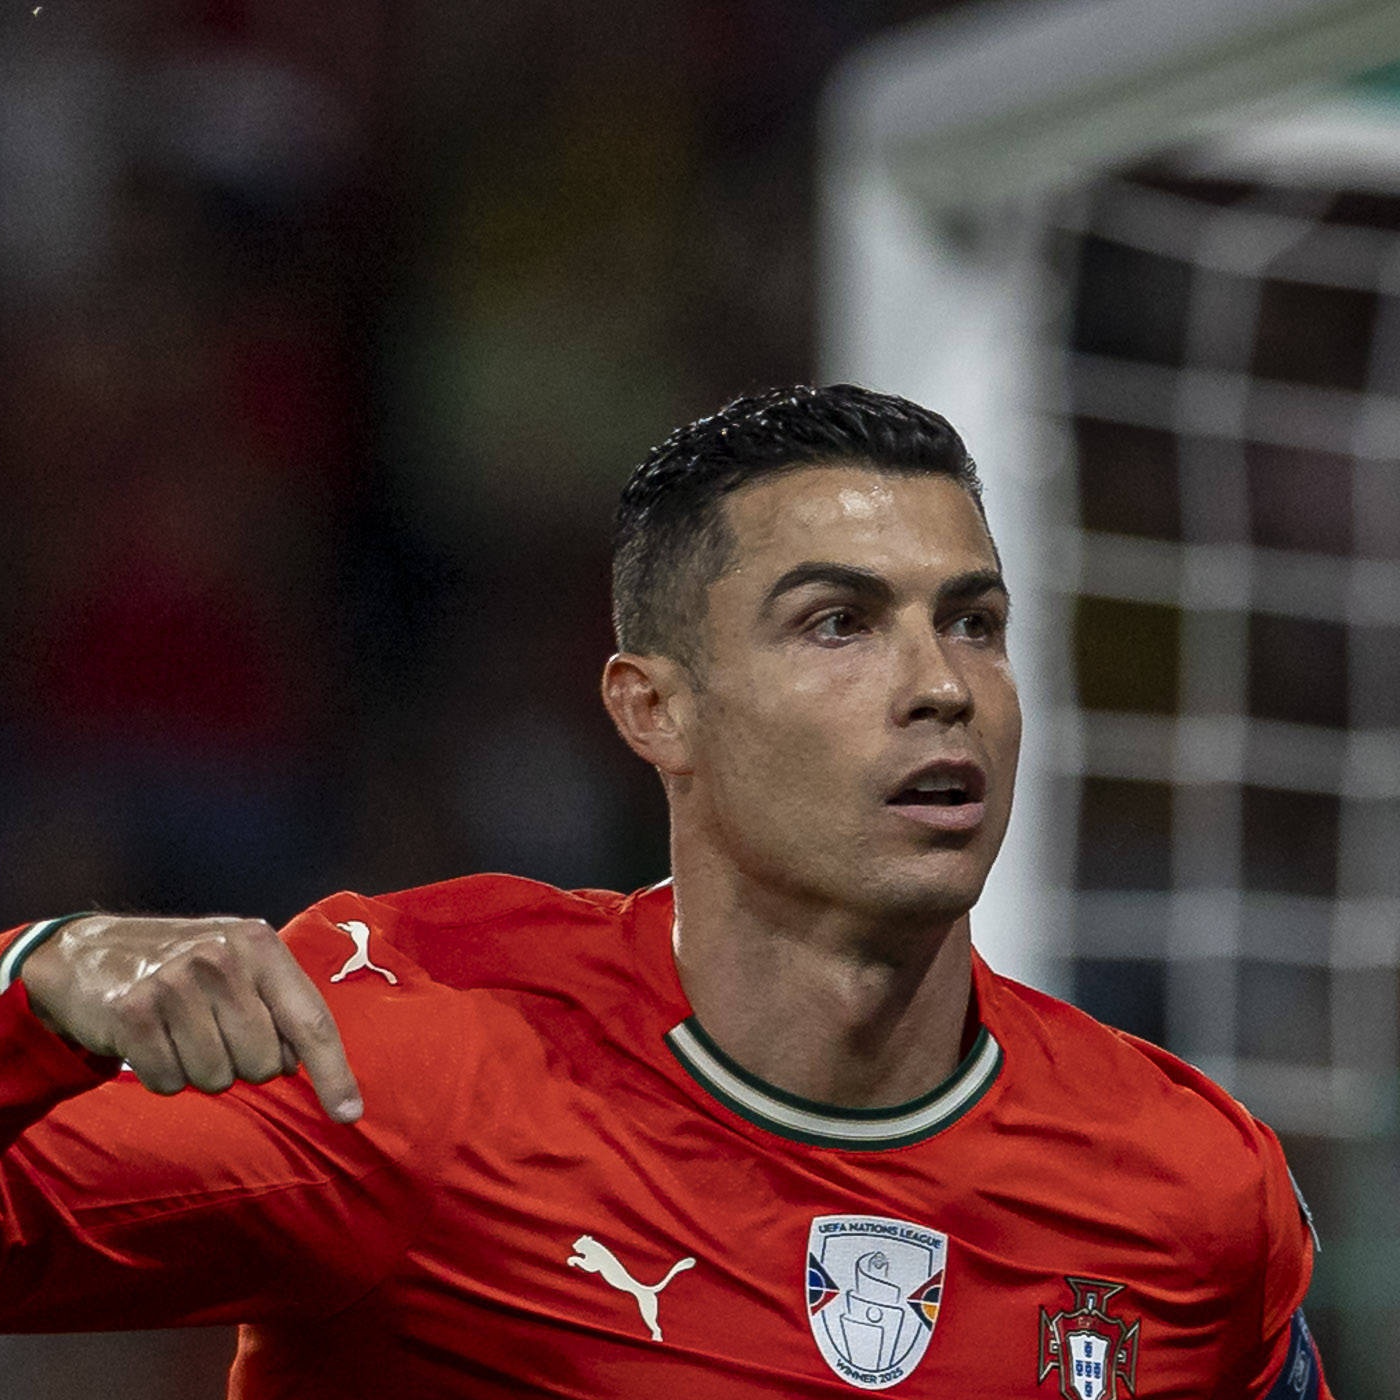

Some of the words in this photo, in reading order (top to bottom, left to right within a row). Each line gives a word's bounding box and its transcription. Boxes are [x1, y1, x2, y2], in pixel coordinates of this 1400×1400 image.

[818, 1223, 847, 1233] UEFA
[849, 1223, 898, 1236] NATIONS
[900, 1228, 943, 1249] LEAGUE
[836, 1358, 878, 1384] WINNER
[879, 1367, 904, 1383] 2025
